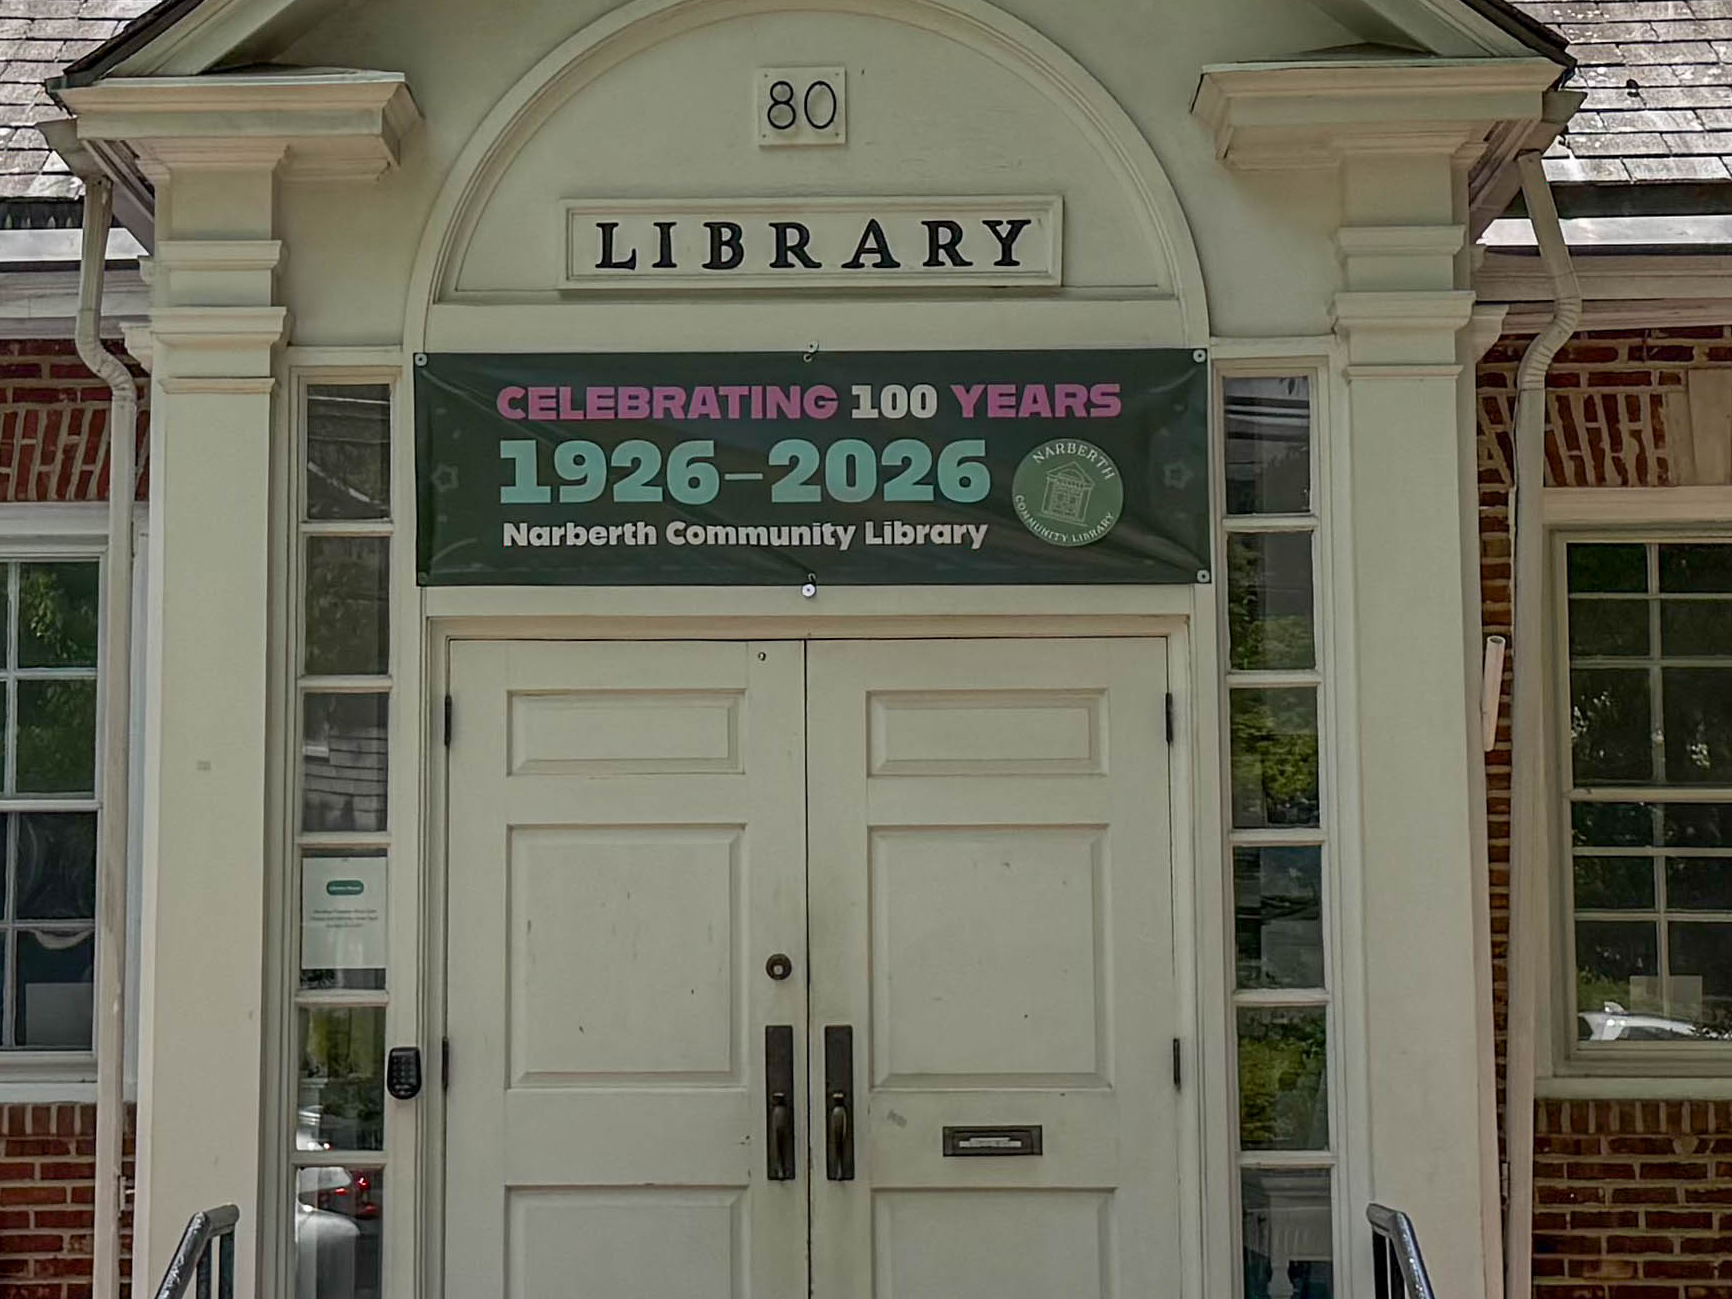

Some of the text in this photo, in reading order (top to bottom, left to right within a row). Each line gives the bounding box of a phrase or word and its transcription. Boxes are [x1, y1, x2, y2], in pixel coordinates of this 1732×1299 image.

[767, 80, 837, 130] 80
[595, 218, 1032, 270] LIBRARY
[496, 383, 1122, 420] CELEBRATING 100 YEARS
[1032, 442, 1116, 480] NARBERTH
[503, 520, 989, 551] Narberth Community Library
[1014, 494, 1115, 543] COMMUNITY LIBRARY
